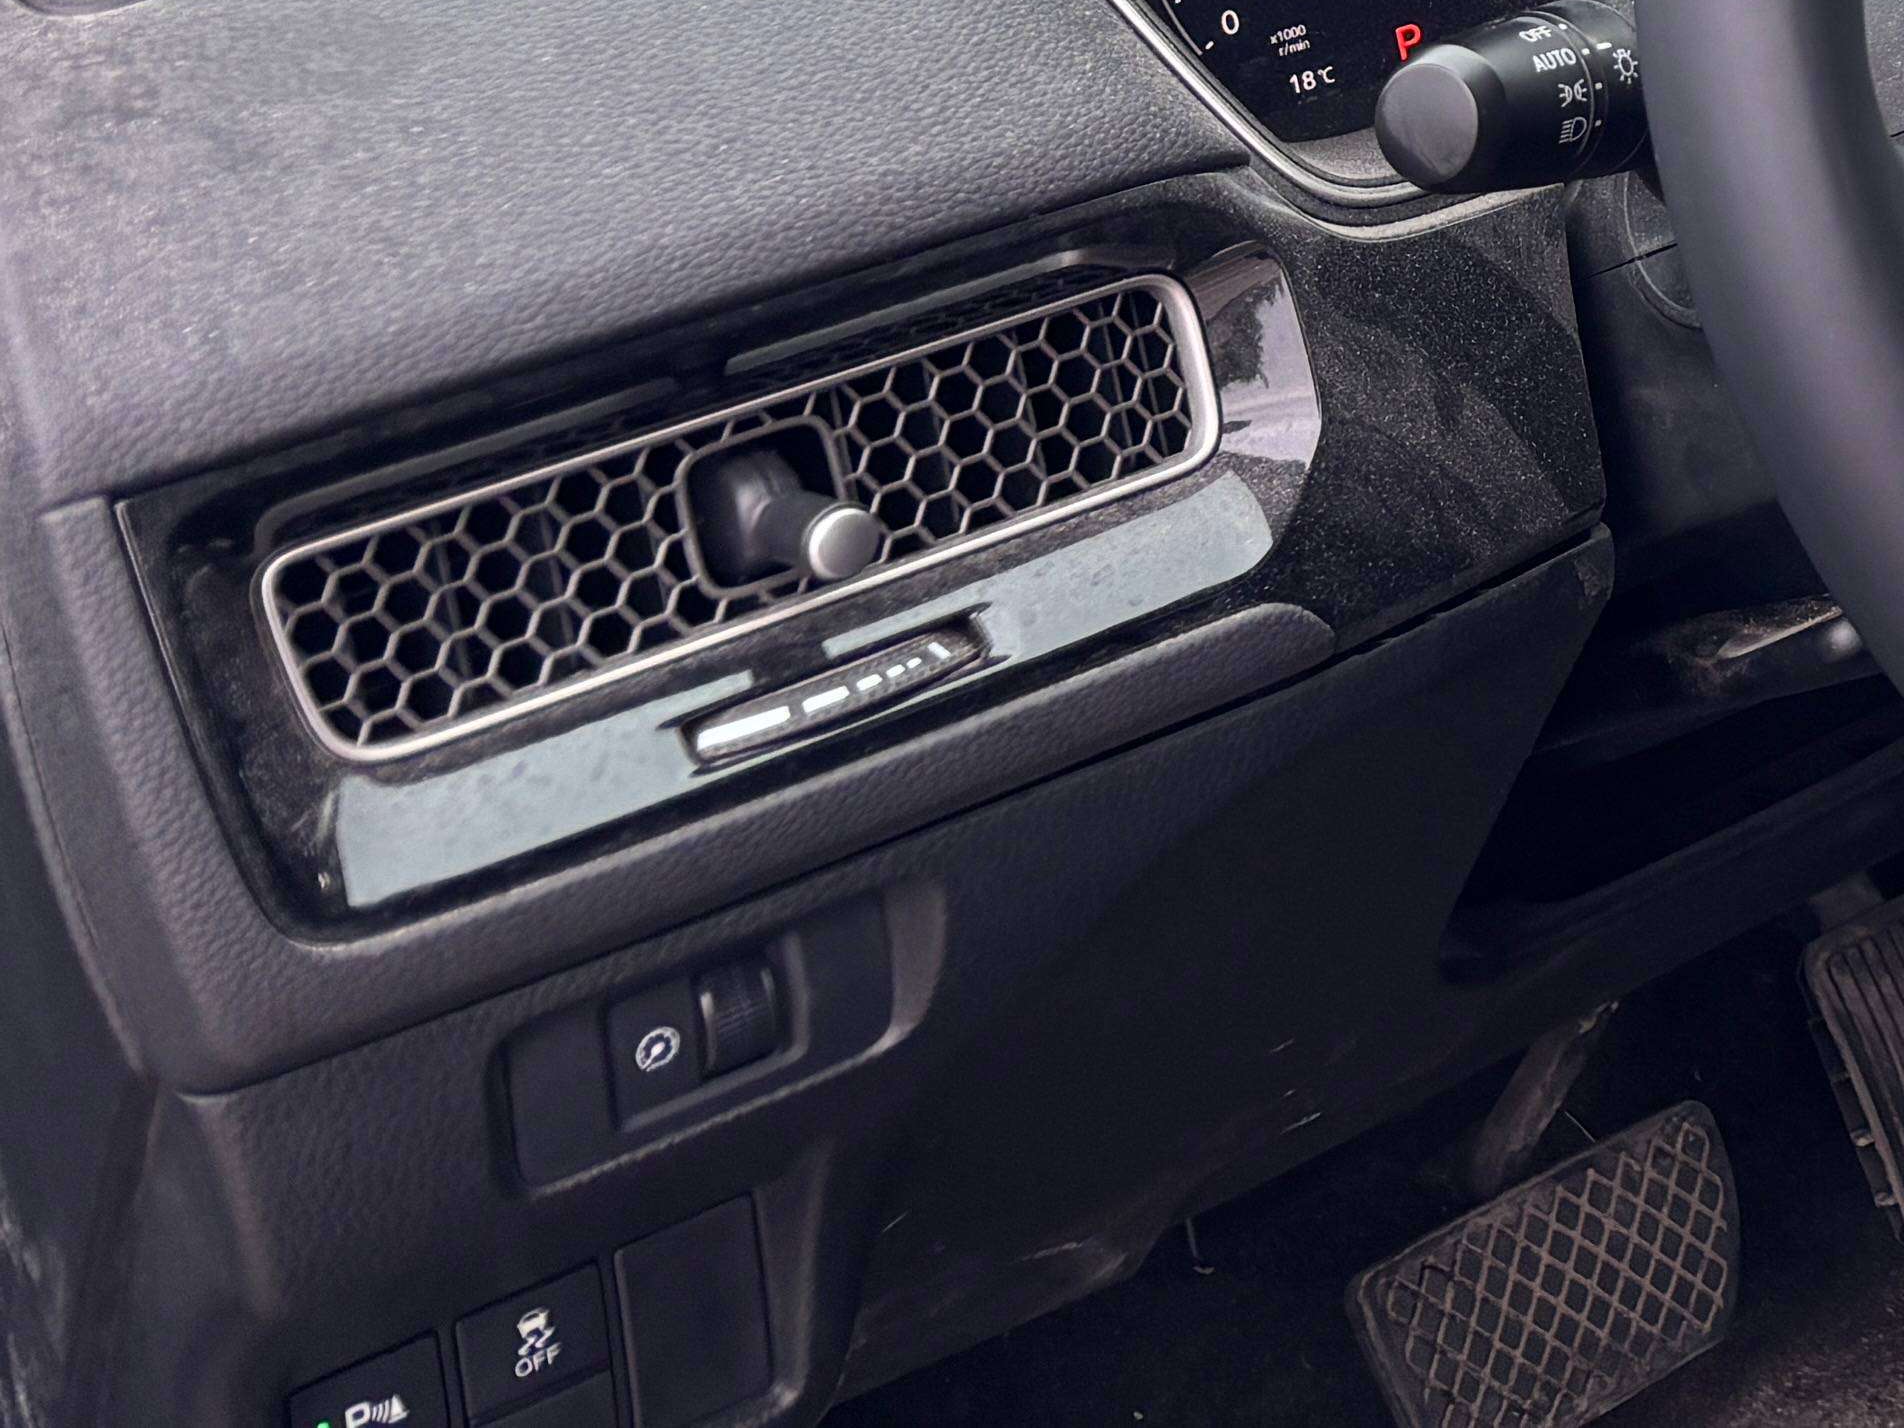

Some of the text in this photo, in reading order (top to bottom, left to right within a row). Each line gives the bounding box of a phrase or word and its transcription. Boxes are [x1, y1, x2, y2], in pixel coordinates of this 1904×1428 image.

[1220, 9, 1240, 36] 0
[1269, 24, 1307, 45] x1000
[1518, 24, 1554, 44] OFF
[1278, 38, 1310, 58] r/min
[1395, 23, 1422, 61] P
[1532, 46, 1577, 74] AUTO
[514, 1340, 562, 1378] OFF
